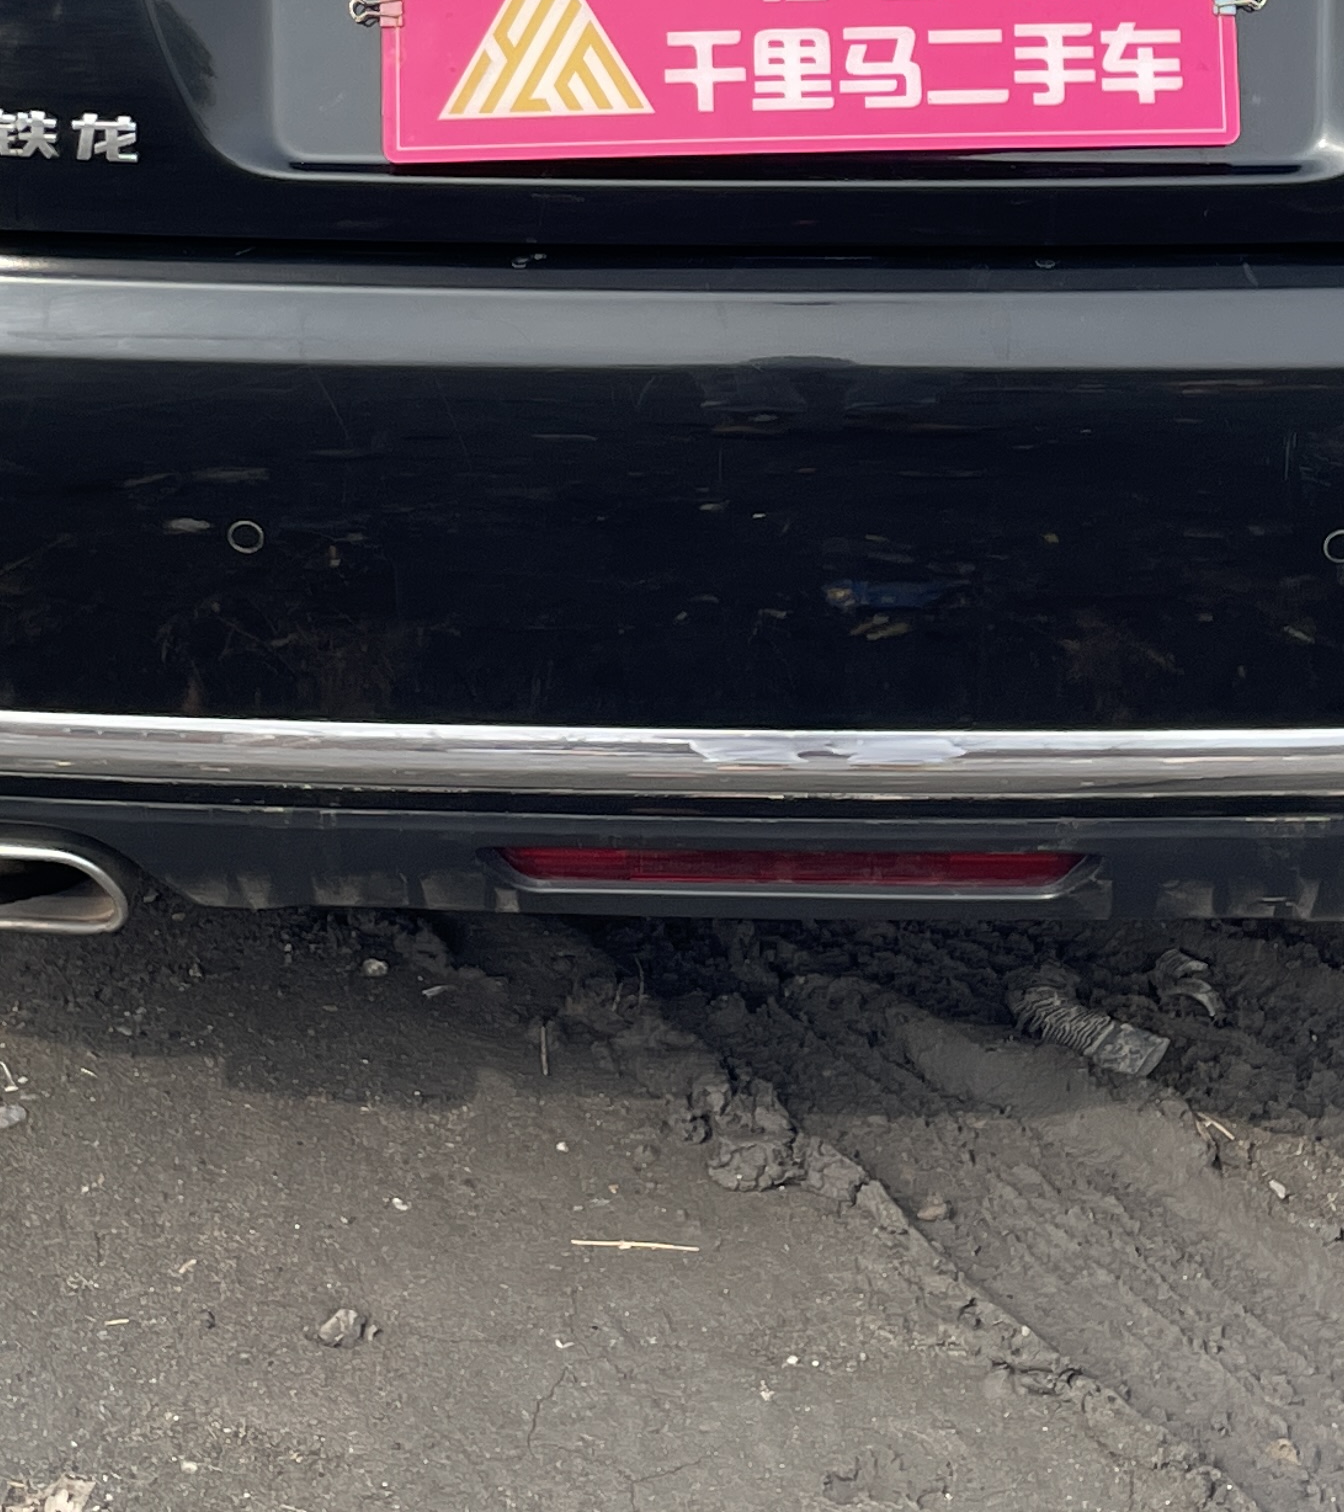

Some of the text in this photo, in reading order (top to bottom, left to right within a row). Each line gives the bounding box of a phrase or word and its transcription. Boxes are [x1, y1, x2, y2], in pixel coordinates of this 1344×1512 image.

[664, 21, 1185, 113] 千里马二手车
